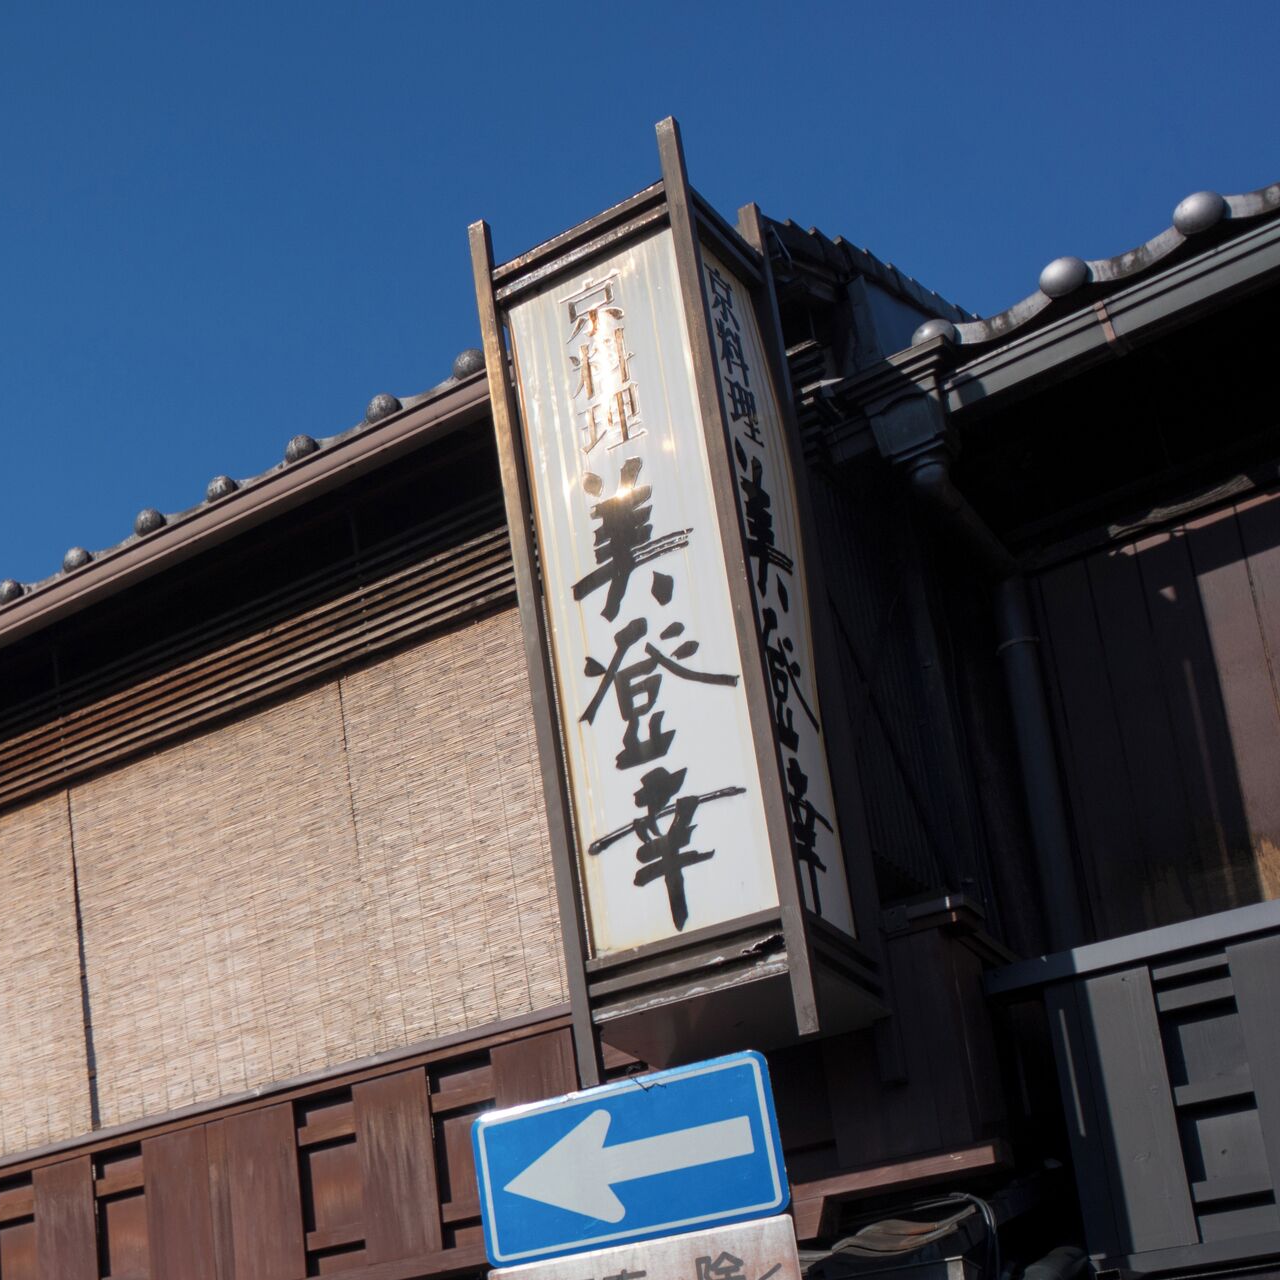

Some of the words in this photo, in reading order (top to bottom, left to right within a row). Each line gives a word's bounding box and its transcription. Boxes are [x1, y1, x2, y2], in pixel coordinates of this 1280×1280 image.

[558, 270, 650, 458] 京料理
[703, 262, 765, 448] 京料理
